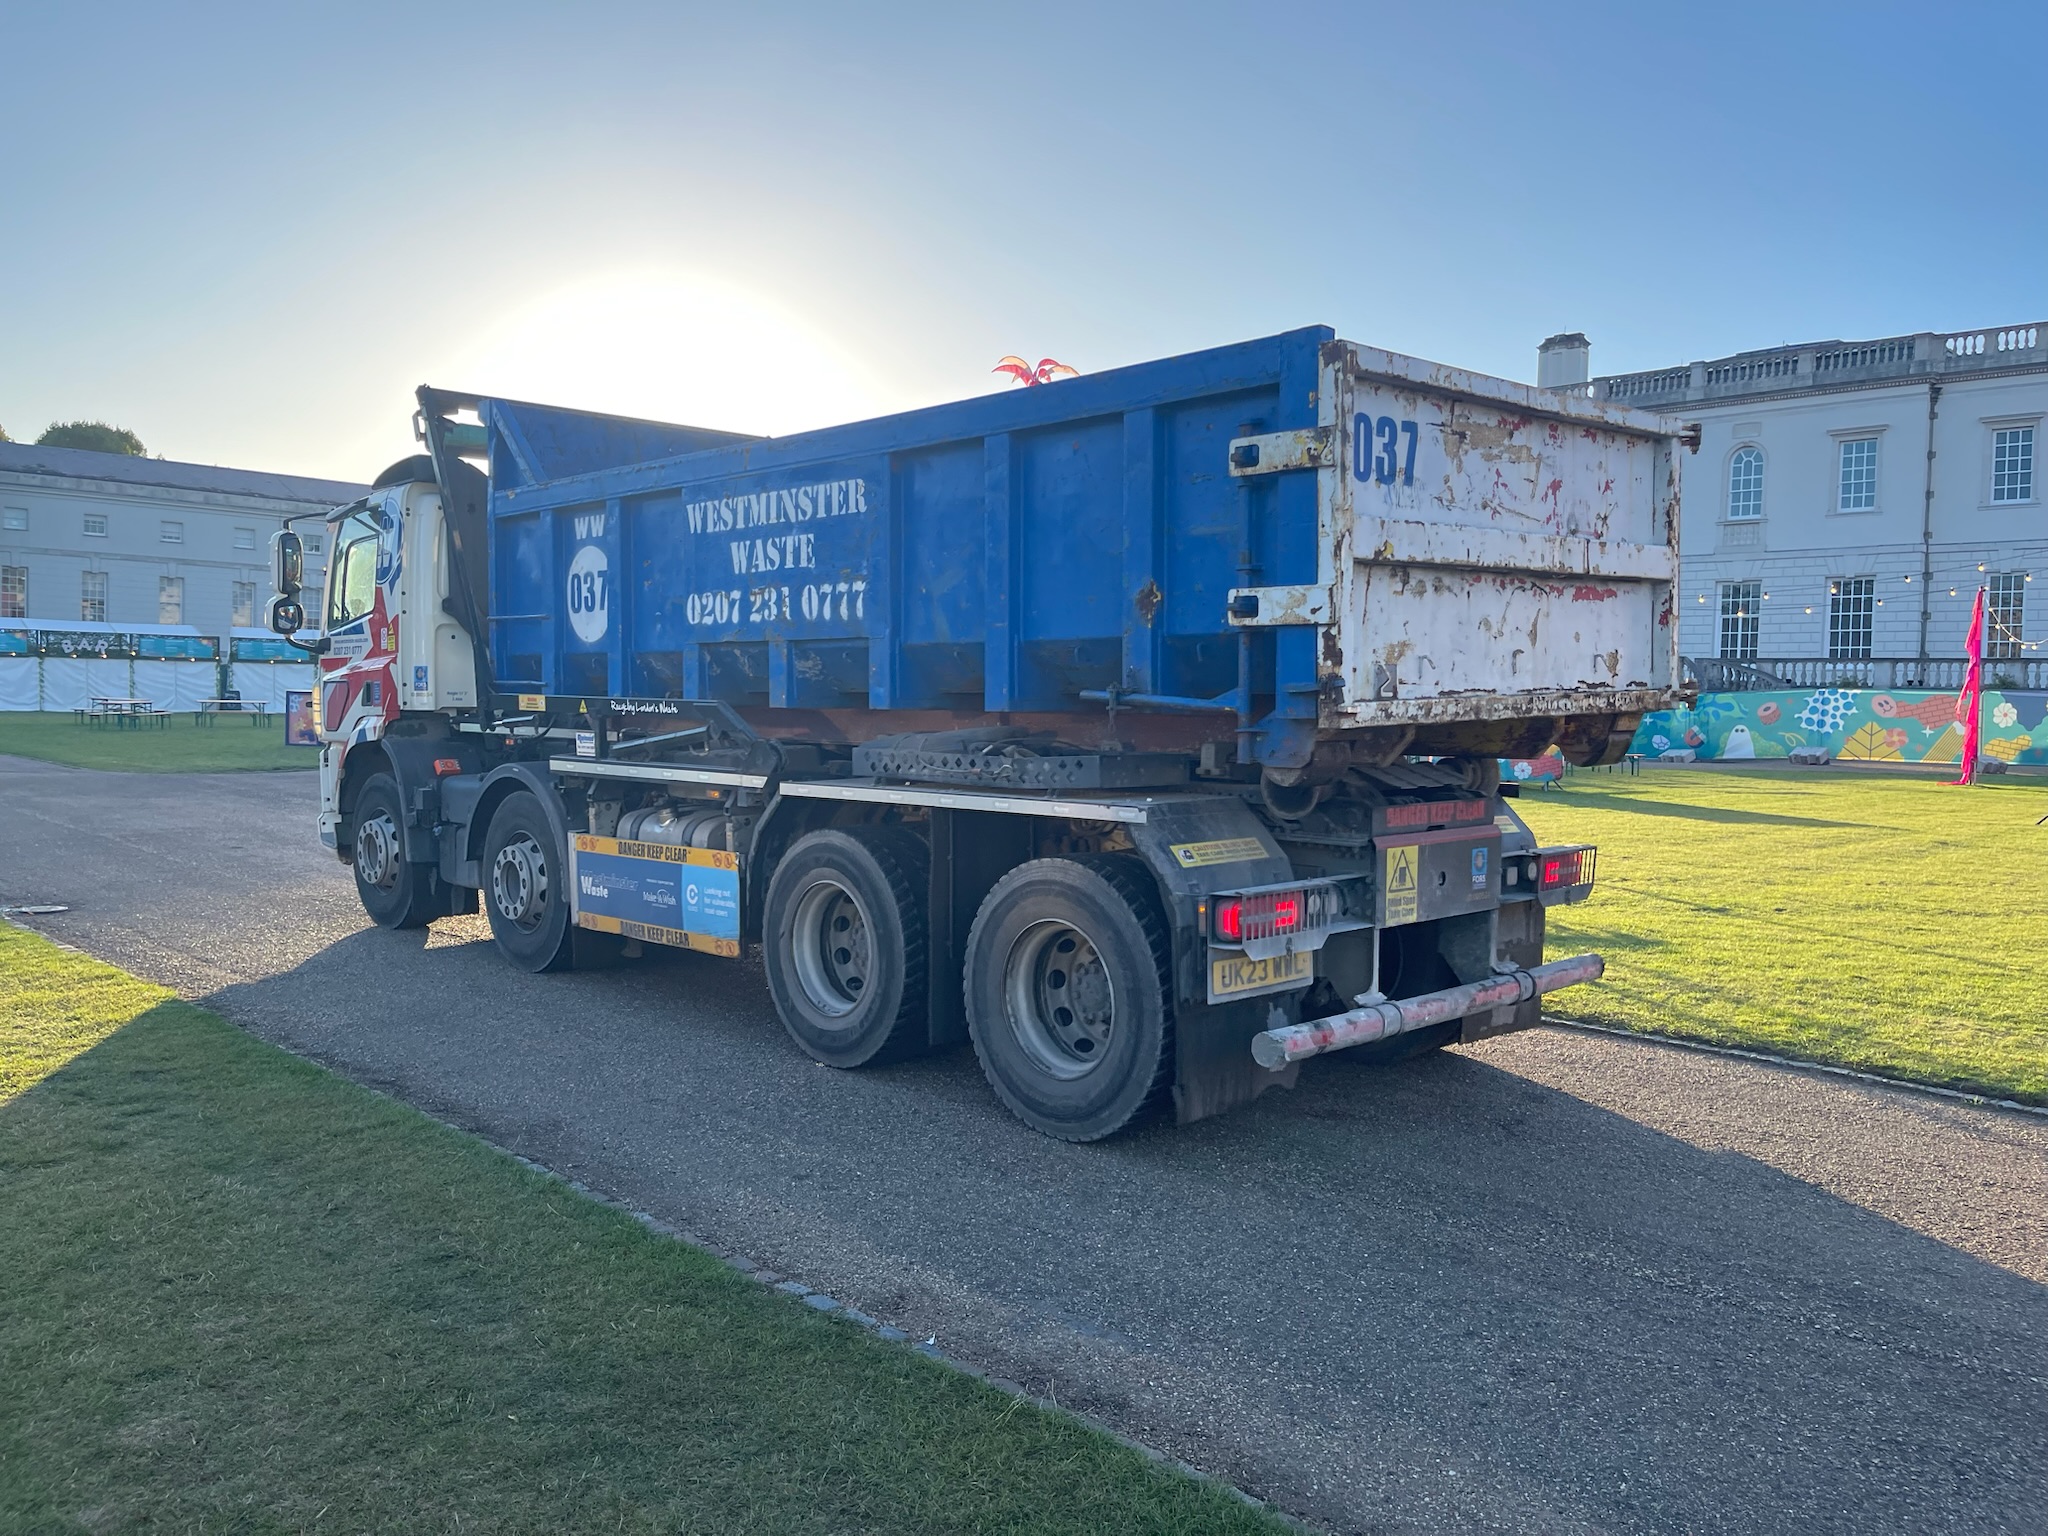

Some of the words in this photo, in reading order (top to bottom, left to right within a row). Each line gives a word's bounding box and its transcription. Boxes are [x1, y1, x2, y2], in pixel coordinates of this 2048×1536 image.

[1353, 412, 1419, 487] 037
[686, 478, 868, 535] WESTMINSTER
[574, 514, 606, 541] WW
[730, 533, 816, 575] WASTE
[570, 570, 609, 614] 037
[686, 589, 742, 626] 0207
[750, 586, 792, 624] 231
[801, 580, 867, 622] 0777
[61, 637, 108, 655] BAR
[618, 841, 646, 858] DANGER
[646, 844, 664, 860] KEEP
[665, 846, 688, 863] CLEAR
[581, 875, 609, 899] Waste
[1472, 875, 1486, 883] FORS
[646, 926, 665, 942] KEEP
[665, 929, 690, 947] CLEAR
[1221, 960, 1268, 989] UK23
